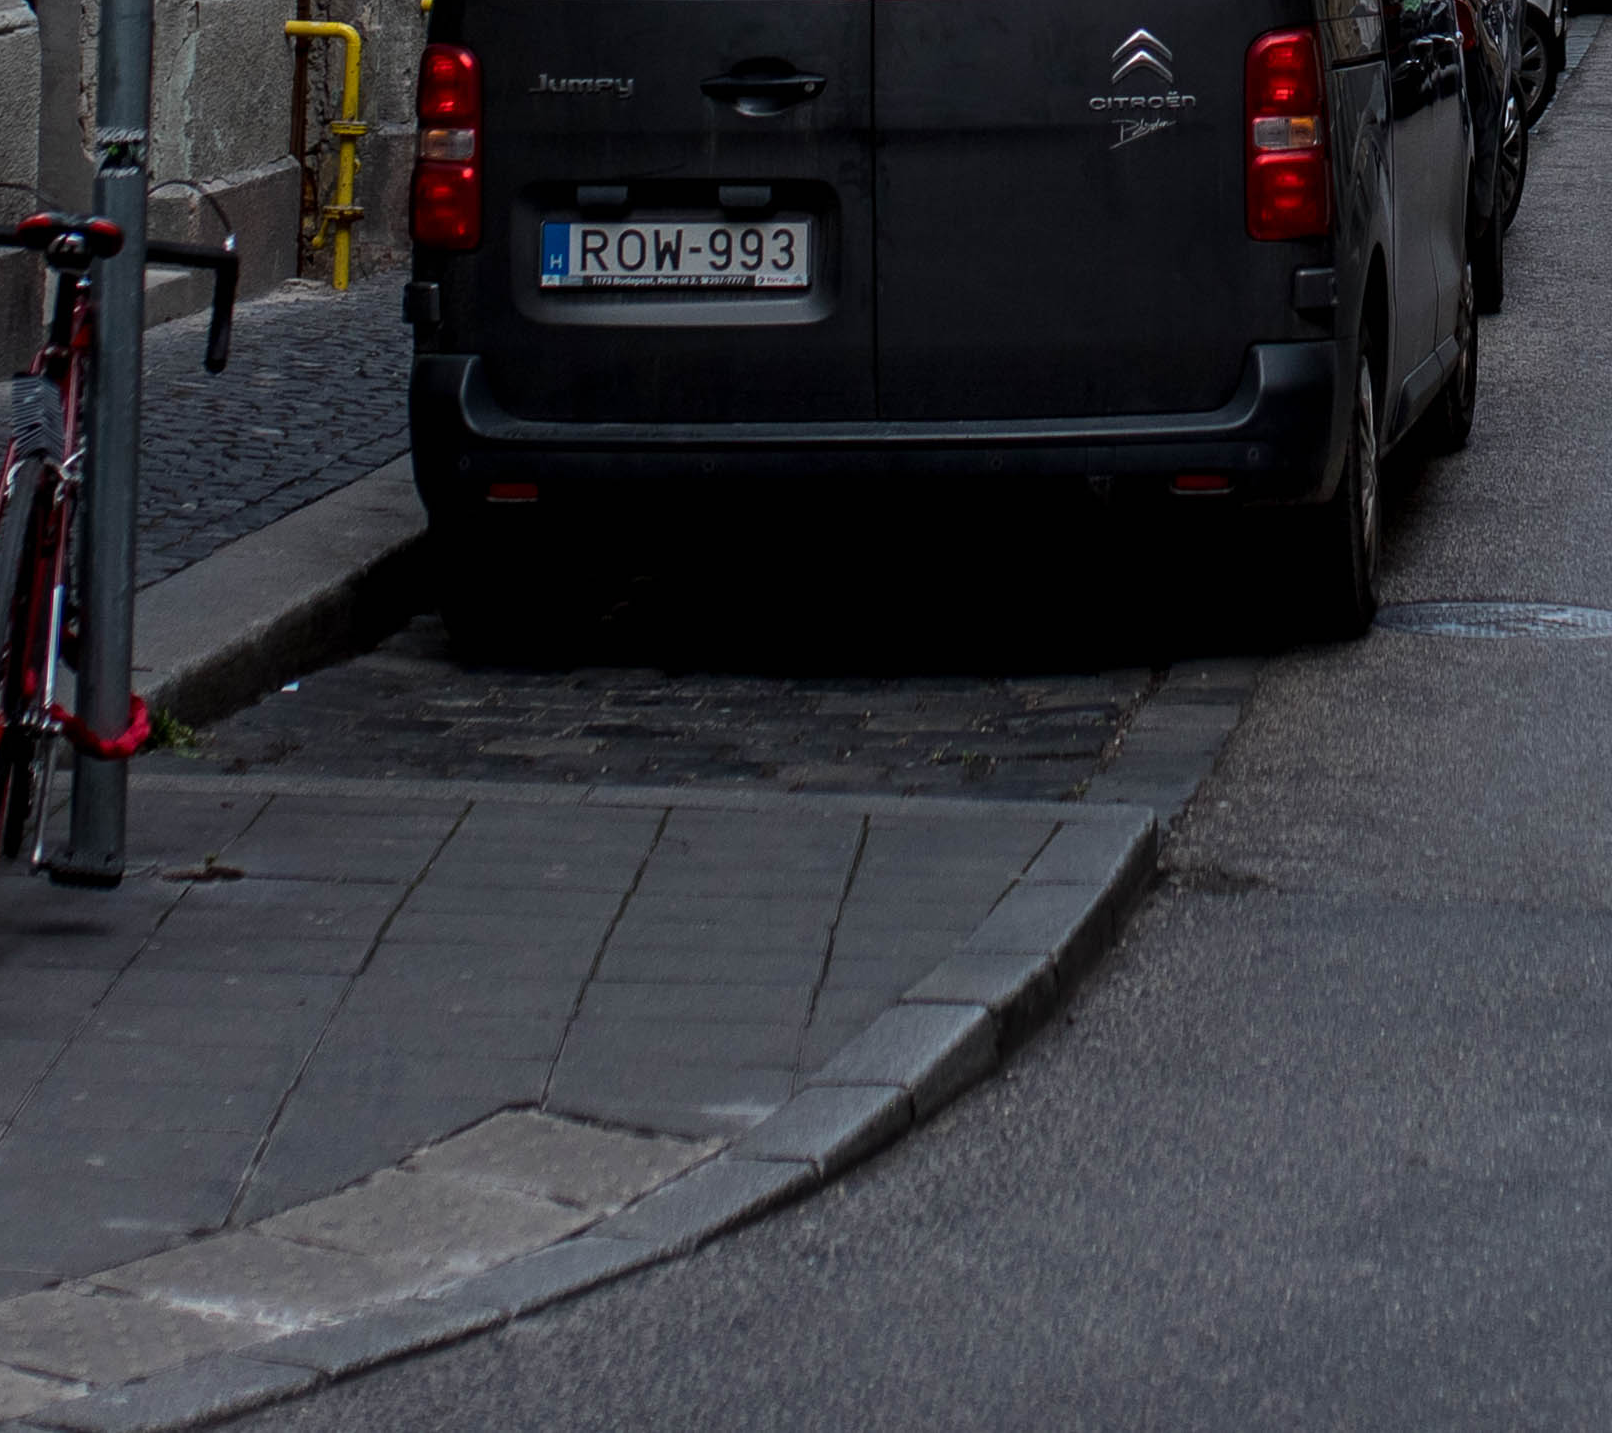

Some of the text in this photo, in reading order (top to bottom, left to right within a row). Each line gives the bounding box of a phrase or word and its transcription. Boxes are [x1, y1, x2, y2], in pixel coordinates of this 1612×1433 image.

[528, 74, 635, 98] Jumpy
[1089, 91, 1196, 110] CITROËN
[580, 228, 795, 272] ROW-993
[550, 254, 563, 269] H
